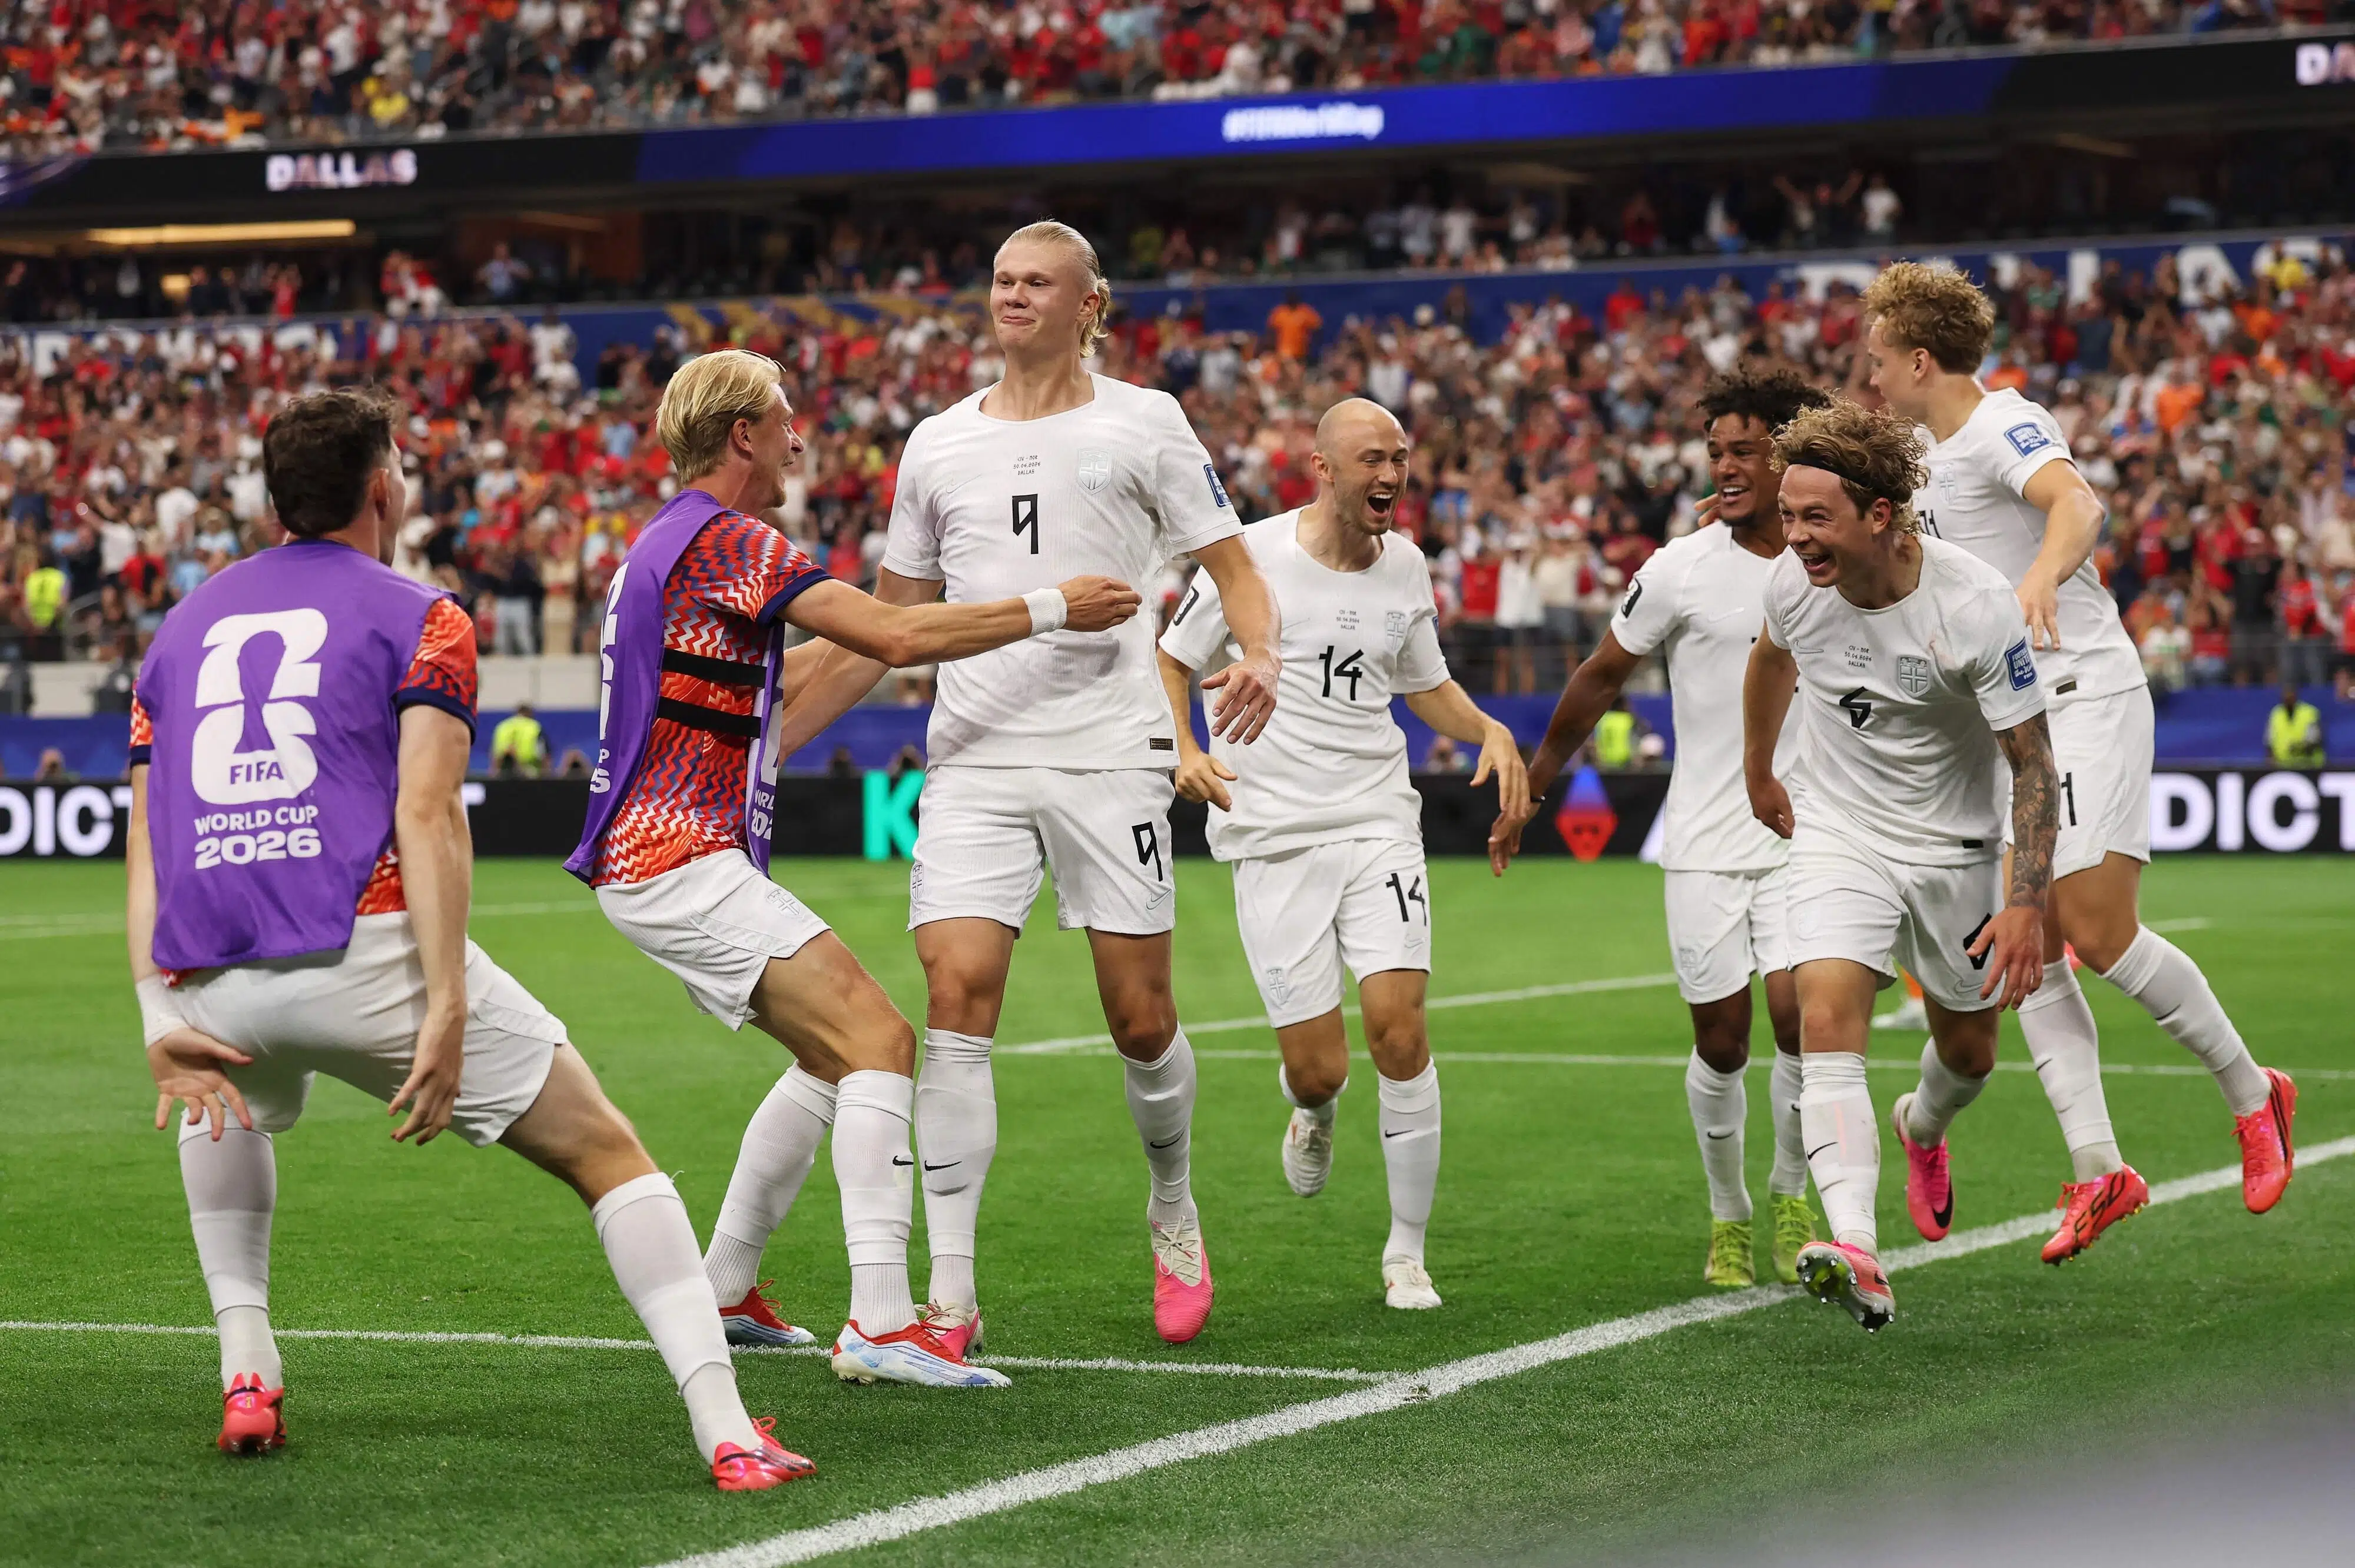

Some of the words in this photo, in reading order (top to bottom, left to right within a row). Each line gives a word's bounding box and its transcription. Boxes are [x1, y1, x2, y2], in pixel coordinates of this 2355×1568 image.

[266, 148, 417, 192] DALLAS
[1012, 493, 1039, 554] 9
[1319, 645, 1364, 700] 14
[230, 761, 284, 785] FIFA
[0, 785, 134, 856] DIC
[194, 809, 272, 836] WORLD
[275, 805, 319, 826] CUP
[2059, 772, 2077, 830] 1
[195, 828, 322, 870] 2026
[1132, 821, 1163, 882] 9
[1385, 872, 1427, 926] 14
